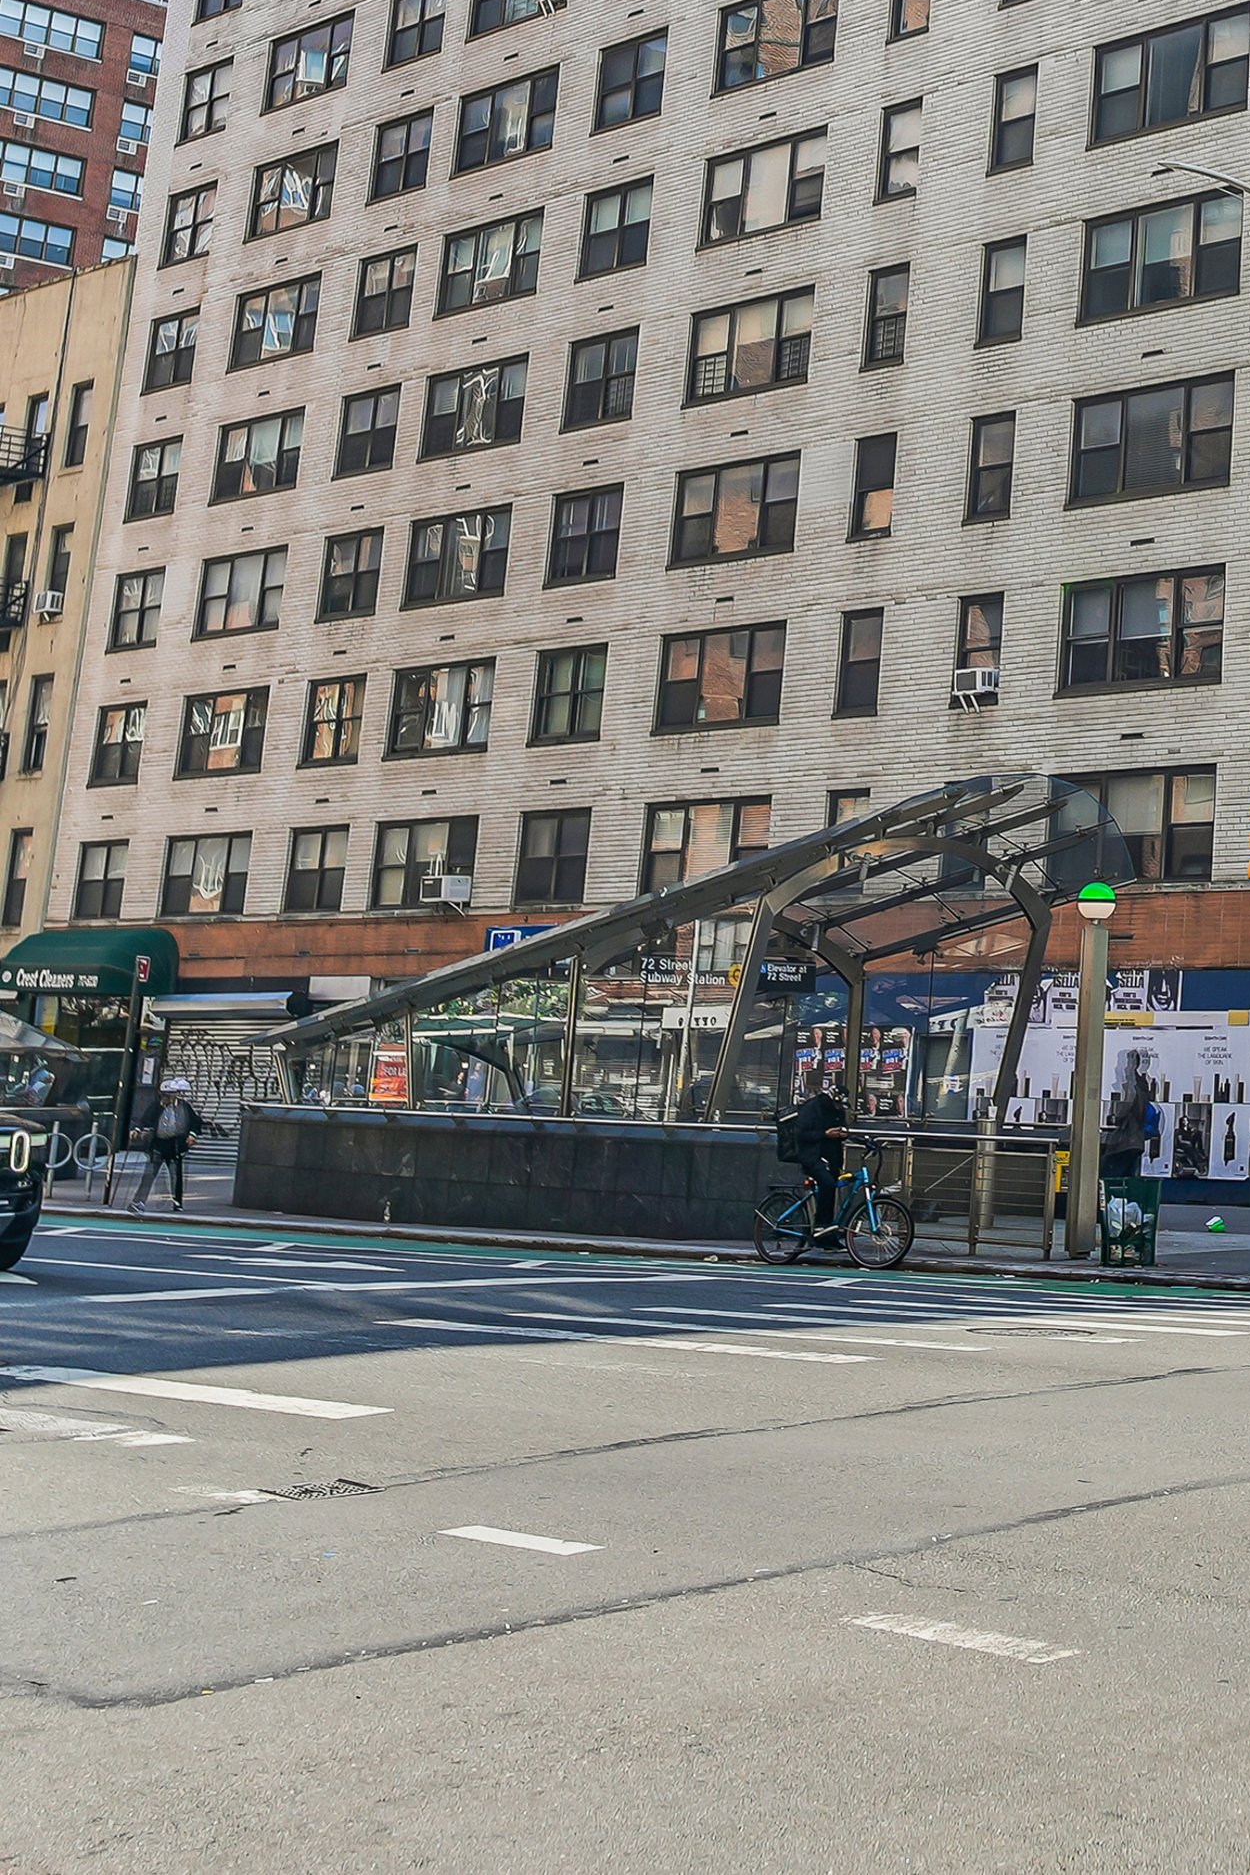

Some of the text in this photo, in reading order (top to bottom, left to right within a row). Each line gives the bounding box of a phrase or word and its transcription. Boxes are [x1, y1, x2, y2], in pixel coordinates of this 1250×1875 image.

[640, 957, 692, 972] 72 Street
[767, 963, 797, 973] Elevator
[640, 970, 726, 986] Subway Station
[767, 972, 802, 982] 72 Street
